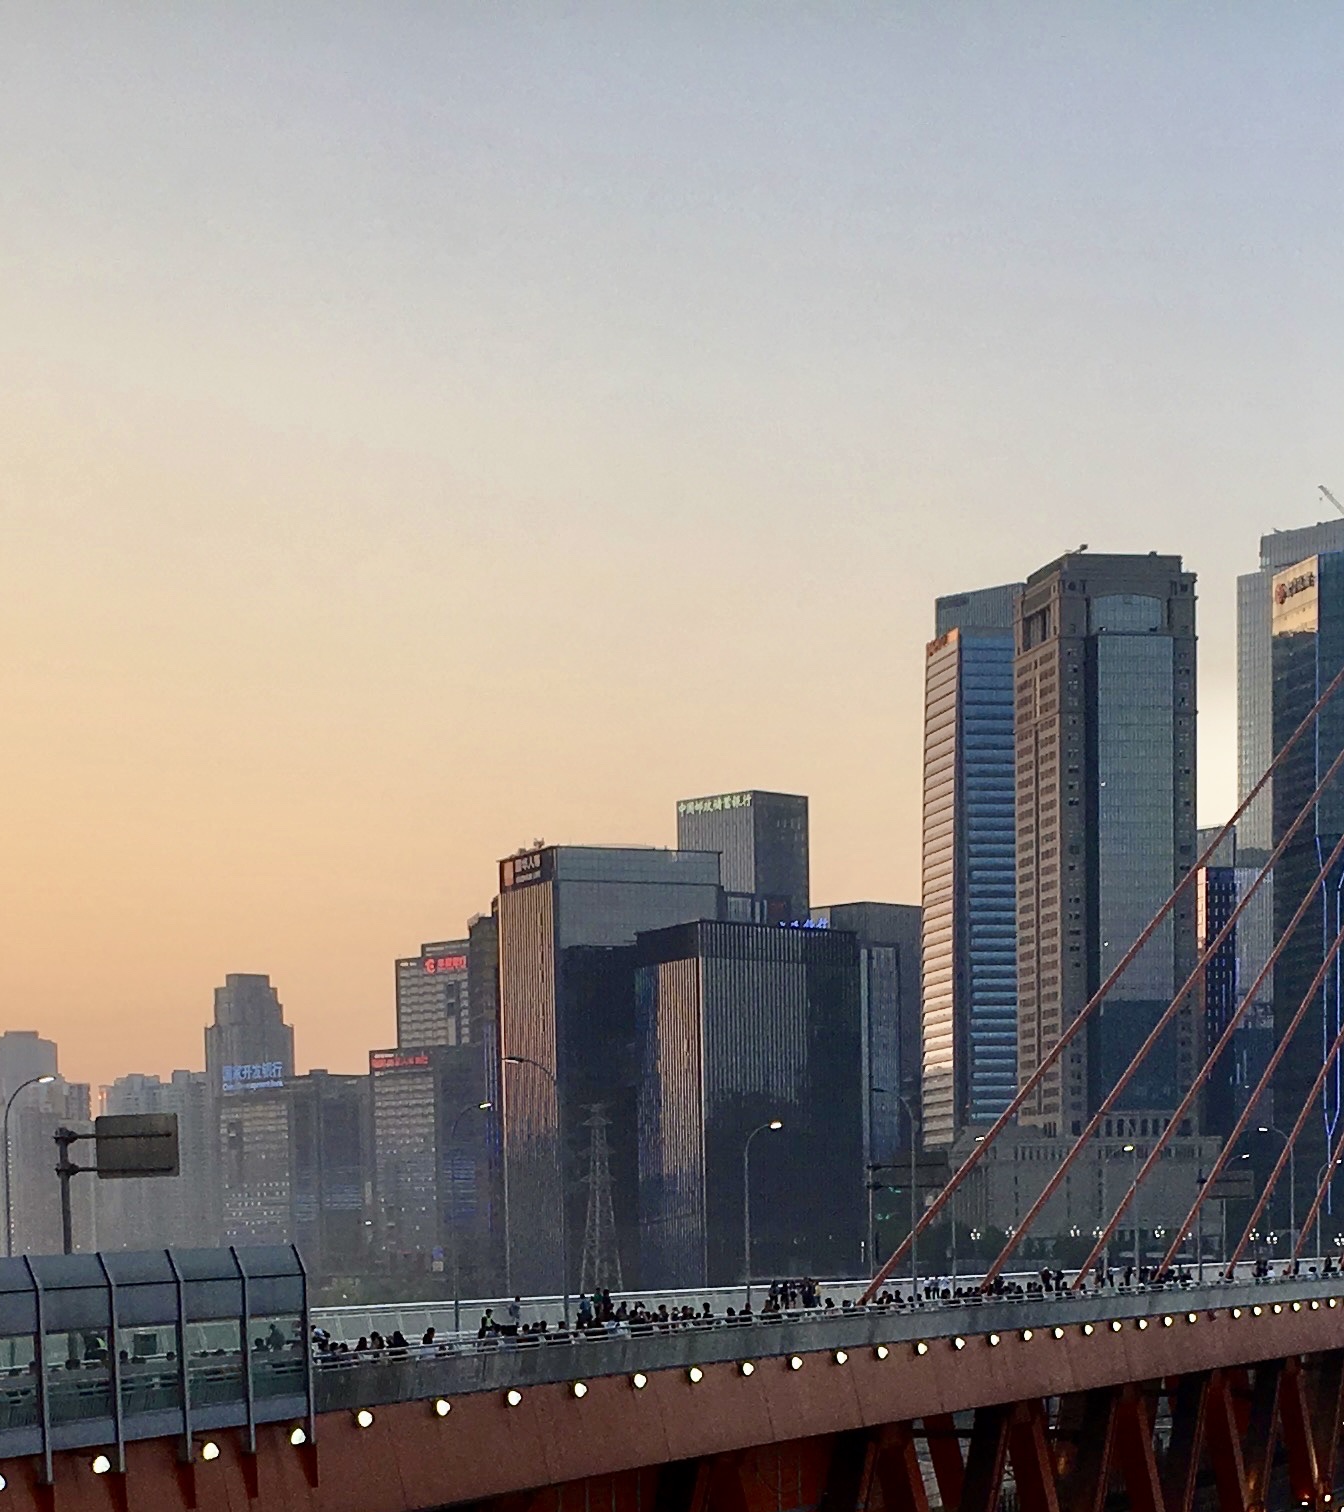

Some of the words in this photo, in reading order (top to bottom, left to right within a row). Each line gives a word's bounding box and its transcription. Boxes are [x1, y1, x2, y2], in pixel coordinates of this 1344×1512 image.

[678, 794, 751, 817] 中国邮政储蓄银行
[223, 1061, 283, 1081] 国家开发银行
